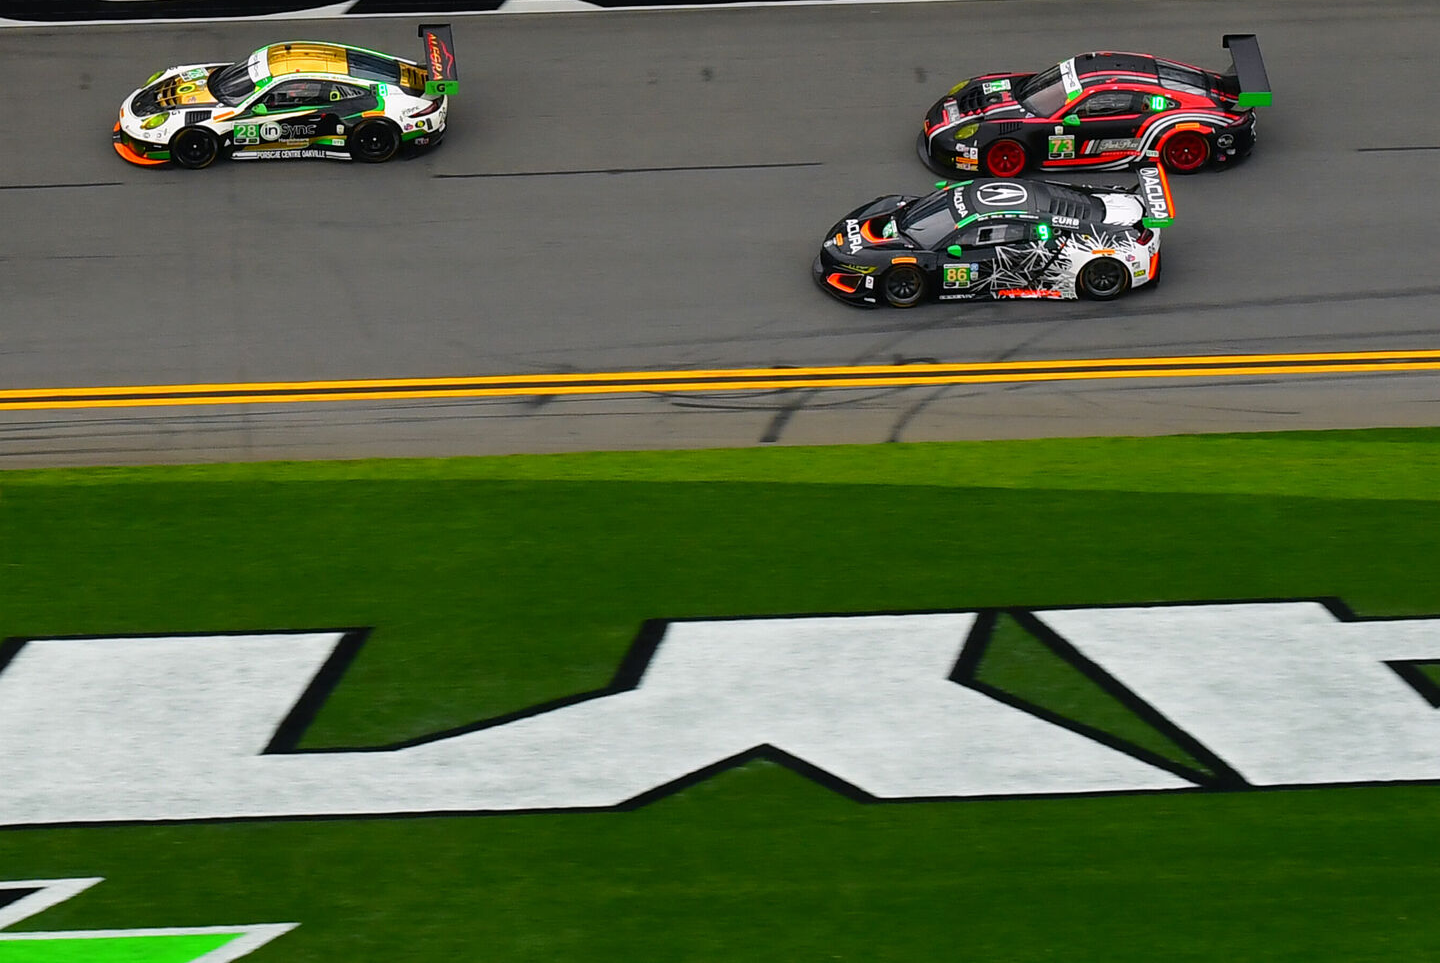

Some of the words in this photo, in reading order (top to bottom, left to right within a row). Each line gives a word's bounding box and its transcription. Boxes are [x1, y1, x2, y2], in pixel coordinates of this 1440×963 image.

[1152, 96, 1164, 110] 10
[236, 124, 257, 138] 28
[1051, 139, 1074, 153] 73
[1143, 176, 1169, 219] ACURA
[1051, 216, 1079, 227] CURB
[846, 219, 864, 255] ACURA
[1037, 224, 1049, 241] 9
[946, 268, 967, 282] 86
